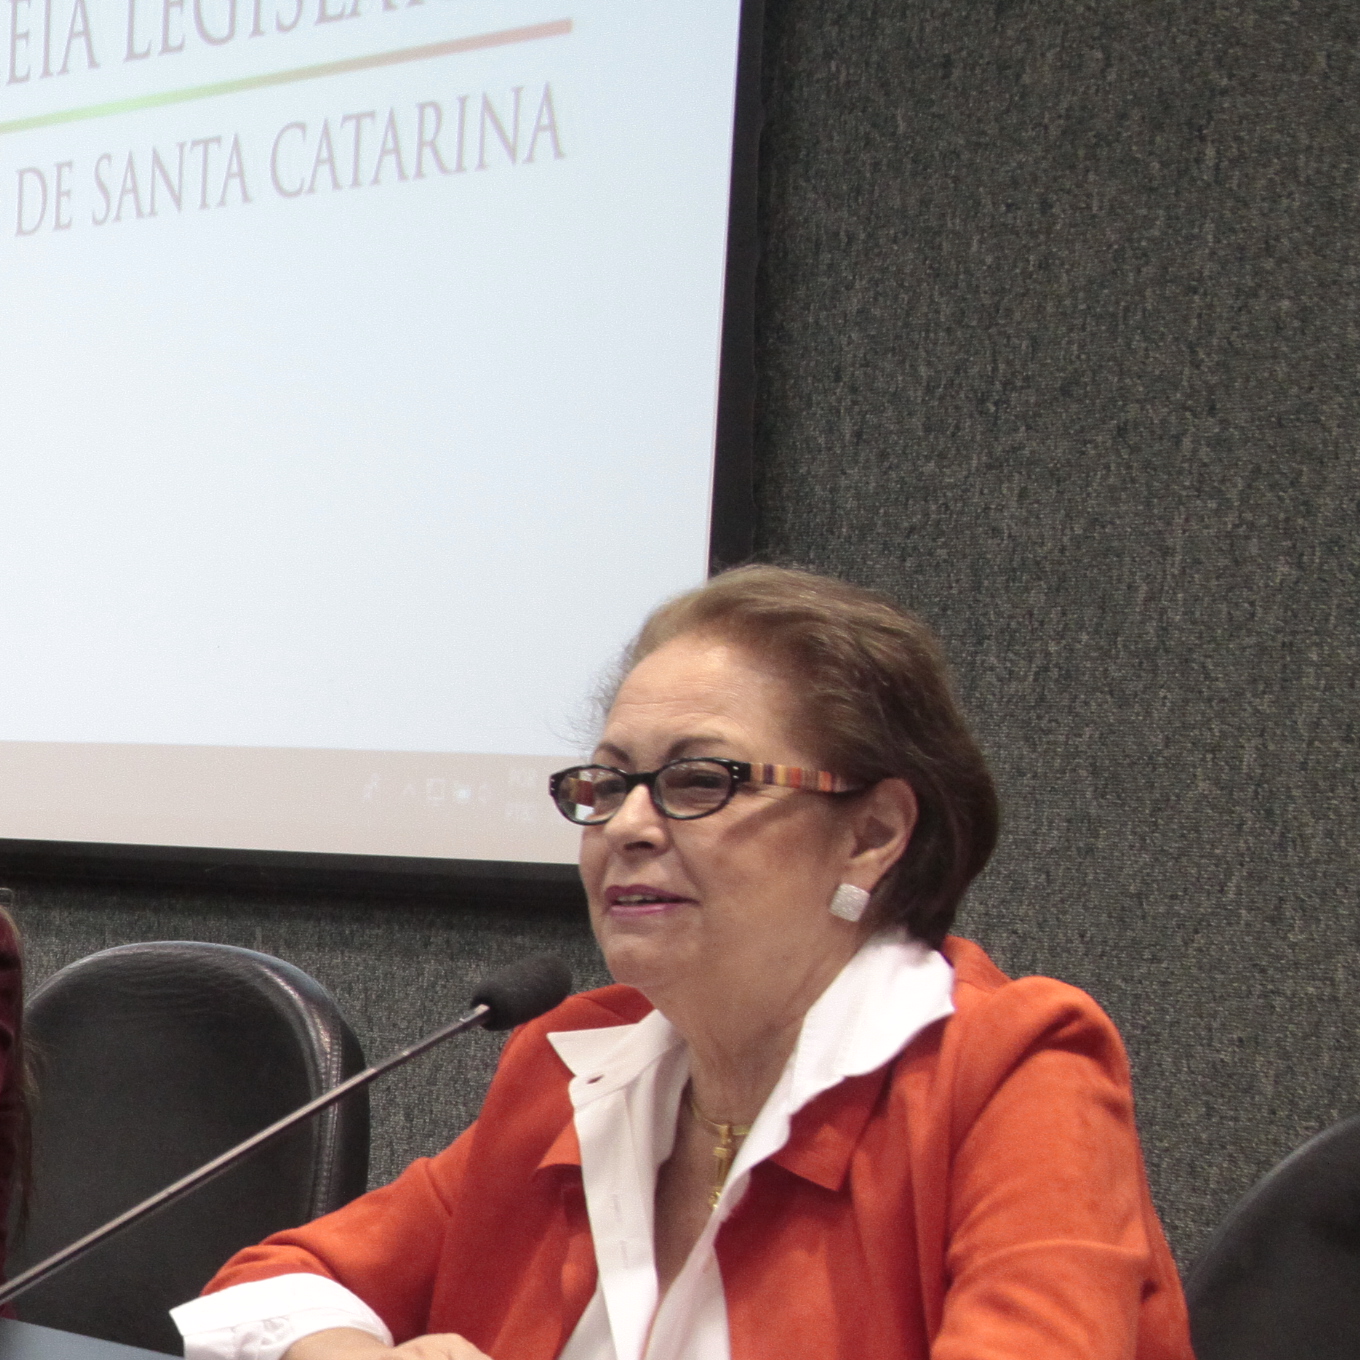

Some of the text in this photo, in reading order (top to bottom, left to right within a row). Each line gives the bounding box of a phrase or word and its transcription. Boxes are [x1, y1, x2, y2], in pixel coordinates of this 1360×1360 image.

[13, 159, 74, 237] DE
[91, 132, 253, 226] SANTA
[269, 80, 567, 199] CATARINA
